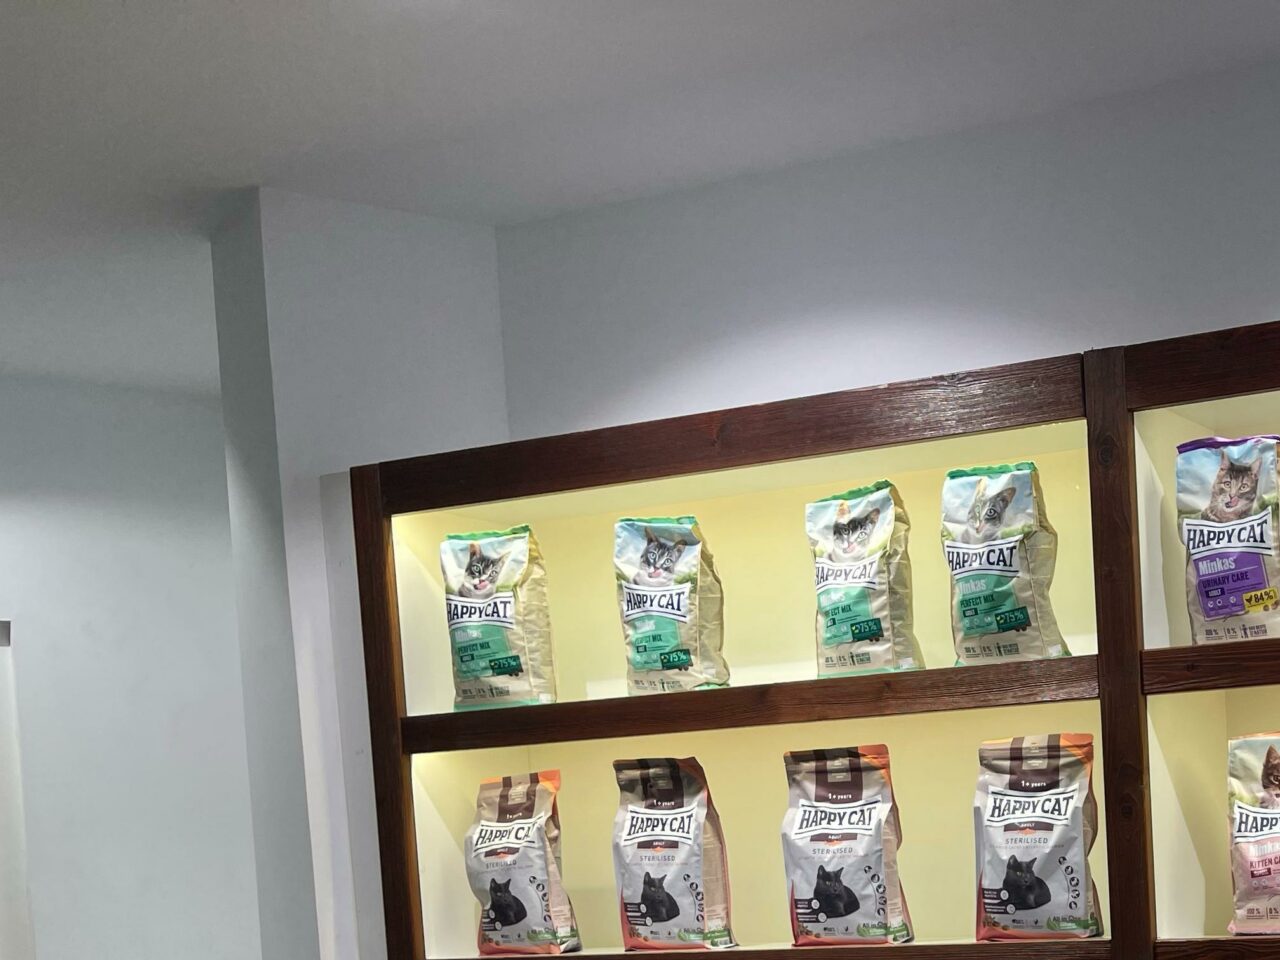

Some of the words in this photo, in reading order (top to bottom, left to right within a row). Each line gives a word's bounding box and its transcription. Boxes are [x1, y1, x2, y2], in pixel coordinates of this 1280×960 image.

[1187, 528, 1236, 550] HAPPY
[1238, 520, 1268, 544] CAT
[946, 550, 986, 572] HAPPY
[986, 546, 1017, 568] CAT
[1198, 558, 1236, 575] Minkas
[816, 566, 852, 585] HAPPY
[852, 561, 876, 580] CAT
[1231, 572, 1250, 582] CARE
[446, 602, 485, 620] HAPPY
[485, 601, 510, 618] CAT
[626, 592, 657, 612] HAPPY
[658, 591, 684, 611] CAT
[960, 596, 982, 607] PERFECT
[983, 594, 994, 603] MIX
[990, 798, 1039, 818] HAPPY
[1041, 796, 1074, 816] CAT
[627, 816, 669, 836] HAPPY
[670, 814, 694, 834] CAT
[798, 808, 845, 830] HAPPY
[848, 806, 876, 826] CAT
[475, 827, 514, 846] HAPPY
[1250, 858, 1272, 868] KITTEN
